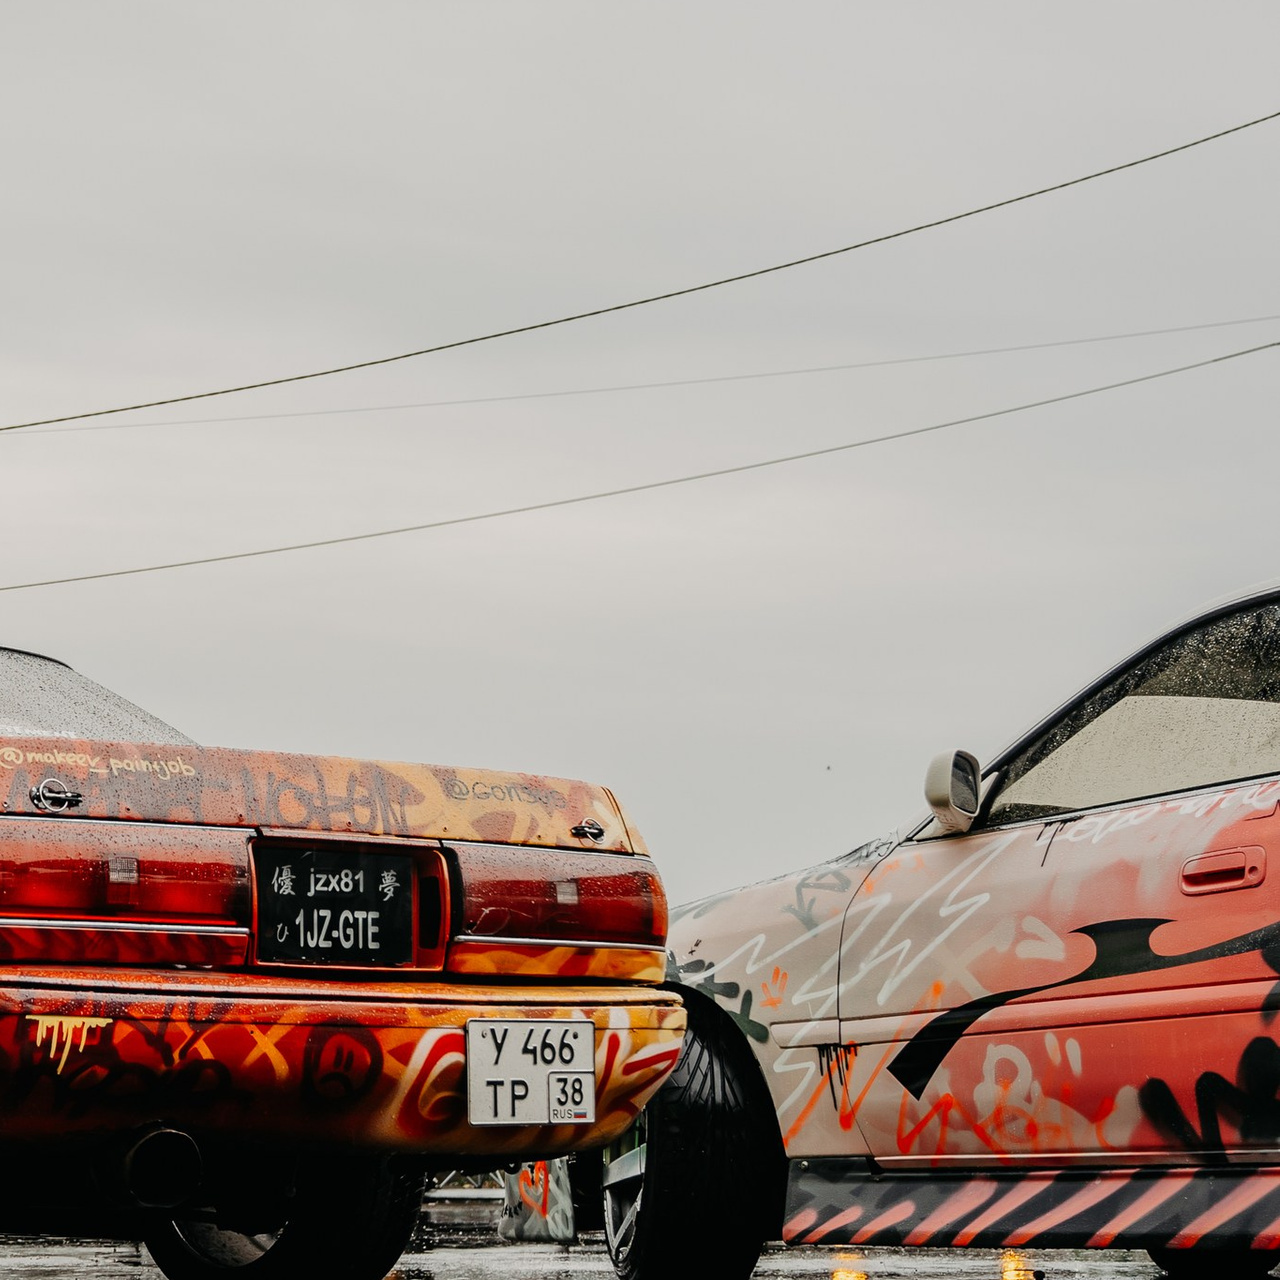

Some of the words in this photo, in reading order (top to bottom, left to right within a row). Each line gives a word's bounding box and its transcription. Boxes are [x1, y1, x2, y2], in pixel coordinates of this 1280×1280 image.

[307, 868, 364, 897] jzx81
[295, 908, 380, 949] 1JZ-GTE
[522, 1028, 575, 1065] 466
[556, 1078, 583, 1106] 38
[552, 1108, 573, 1119] RUS
